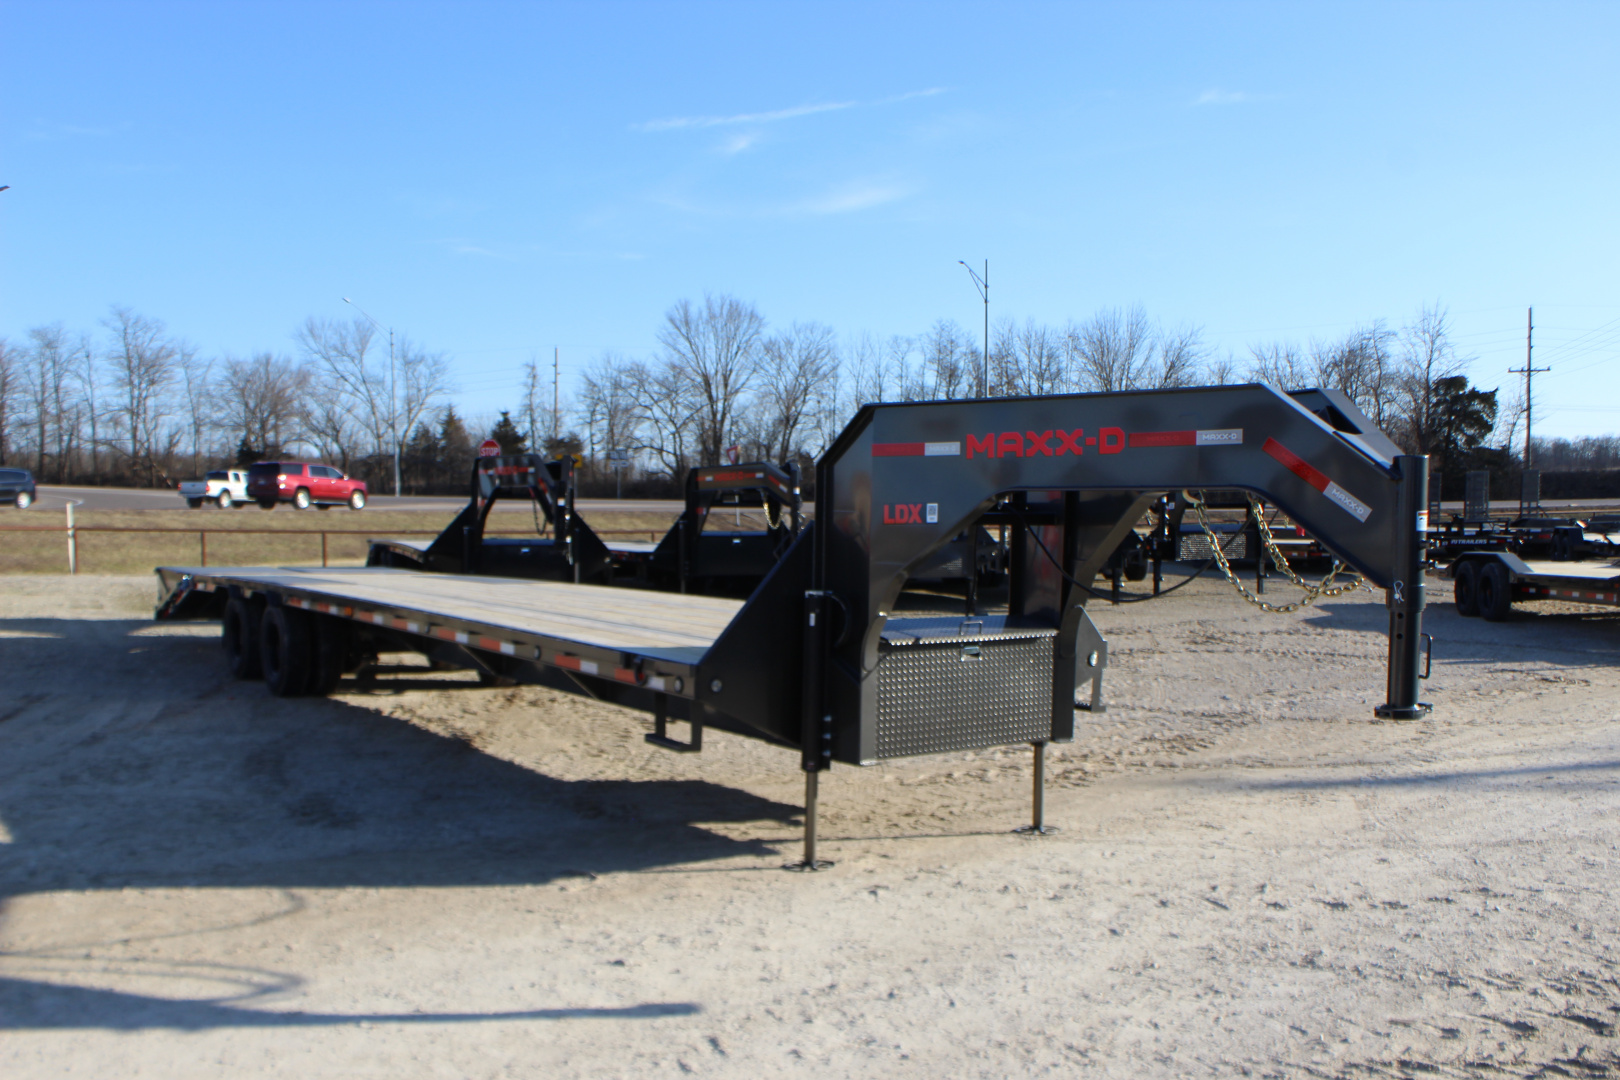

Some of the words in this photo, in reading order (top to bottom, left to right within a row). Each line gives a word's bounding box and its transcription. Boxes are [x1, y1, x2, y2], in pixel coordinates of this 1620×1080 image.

[966, 427, 1125, 459] MAXX-D
[1202, 433, 1238, 441] MAXX-D
[480, 447, 500, 456] STOP
[1331, 488, 1364, 515] MAXX-D
[883, 503, 923, 524] LDX
